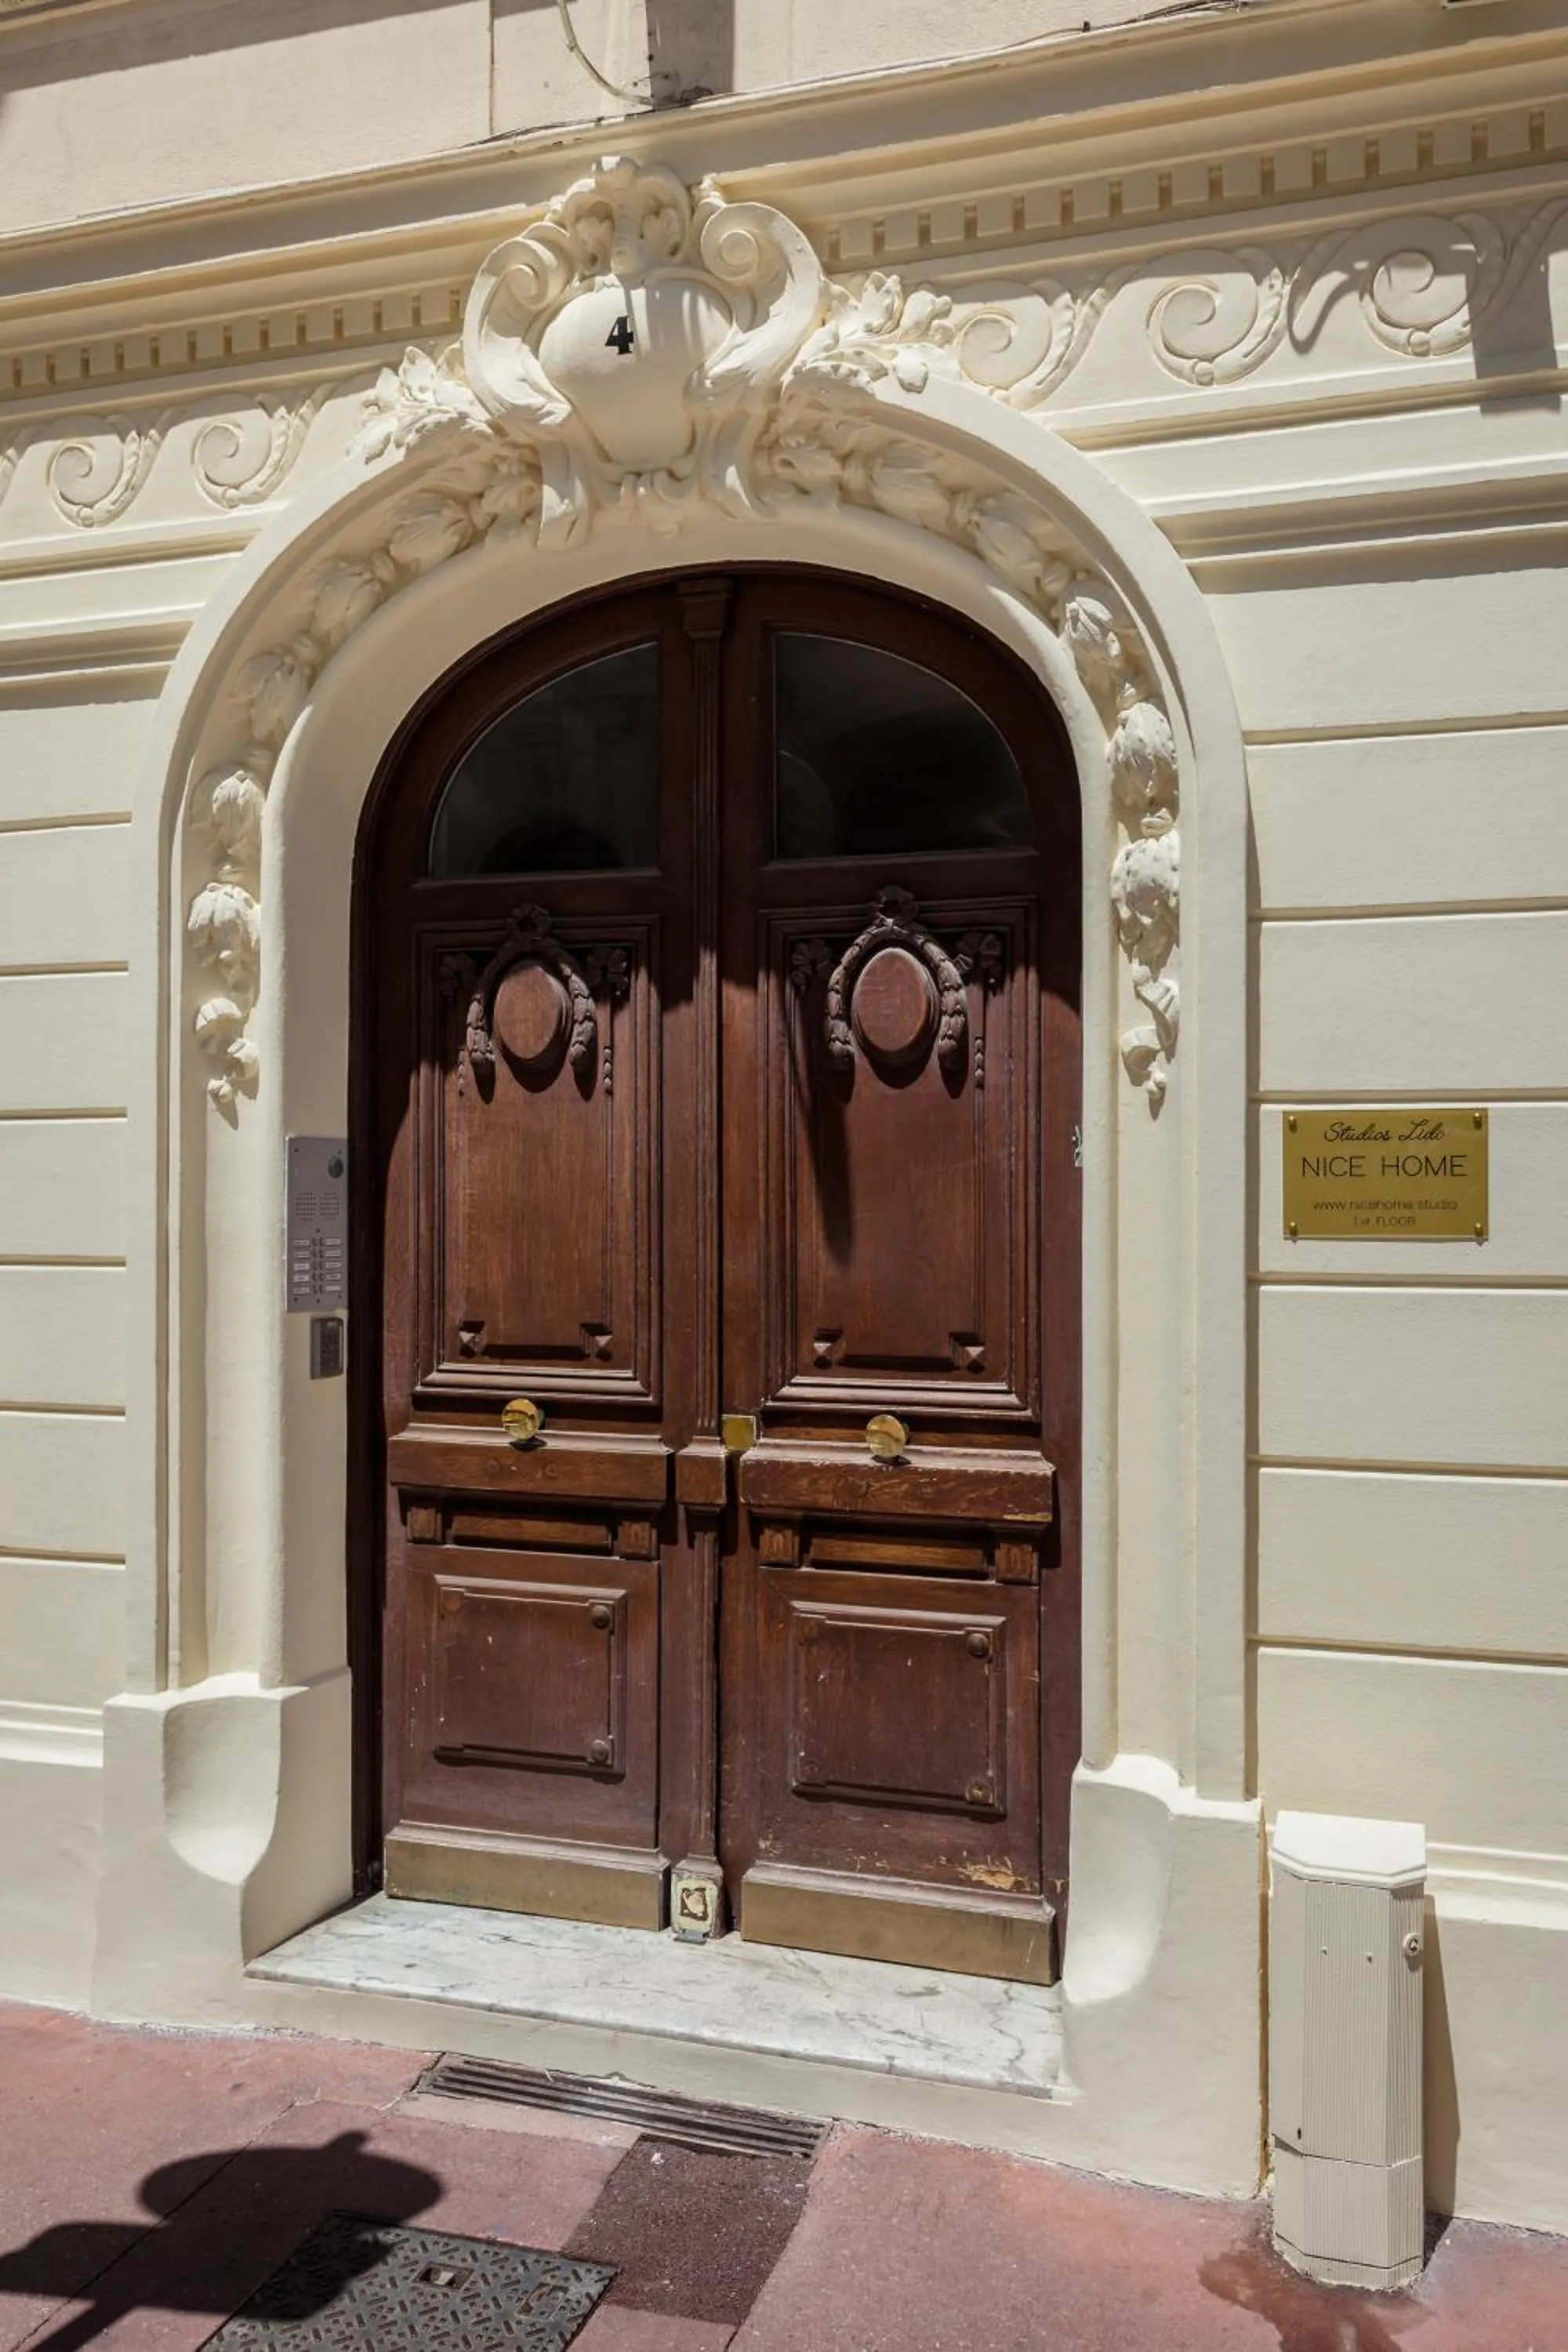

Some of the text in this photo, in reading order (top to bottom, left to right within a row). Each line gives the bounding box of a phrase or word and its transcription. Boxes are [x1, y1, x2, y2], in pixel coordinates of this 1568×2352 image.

[604, 315, 633, 354] 4
[1324, 1119, 1445, 1142] Studios Lido
[1301, 1155, 1468, 1177] NICE HOME
[1313, 1199, 1457, 1210] www.nicehome.studio
[1376, 1216, 1416, 1227] FLOOR
